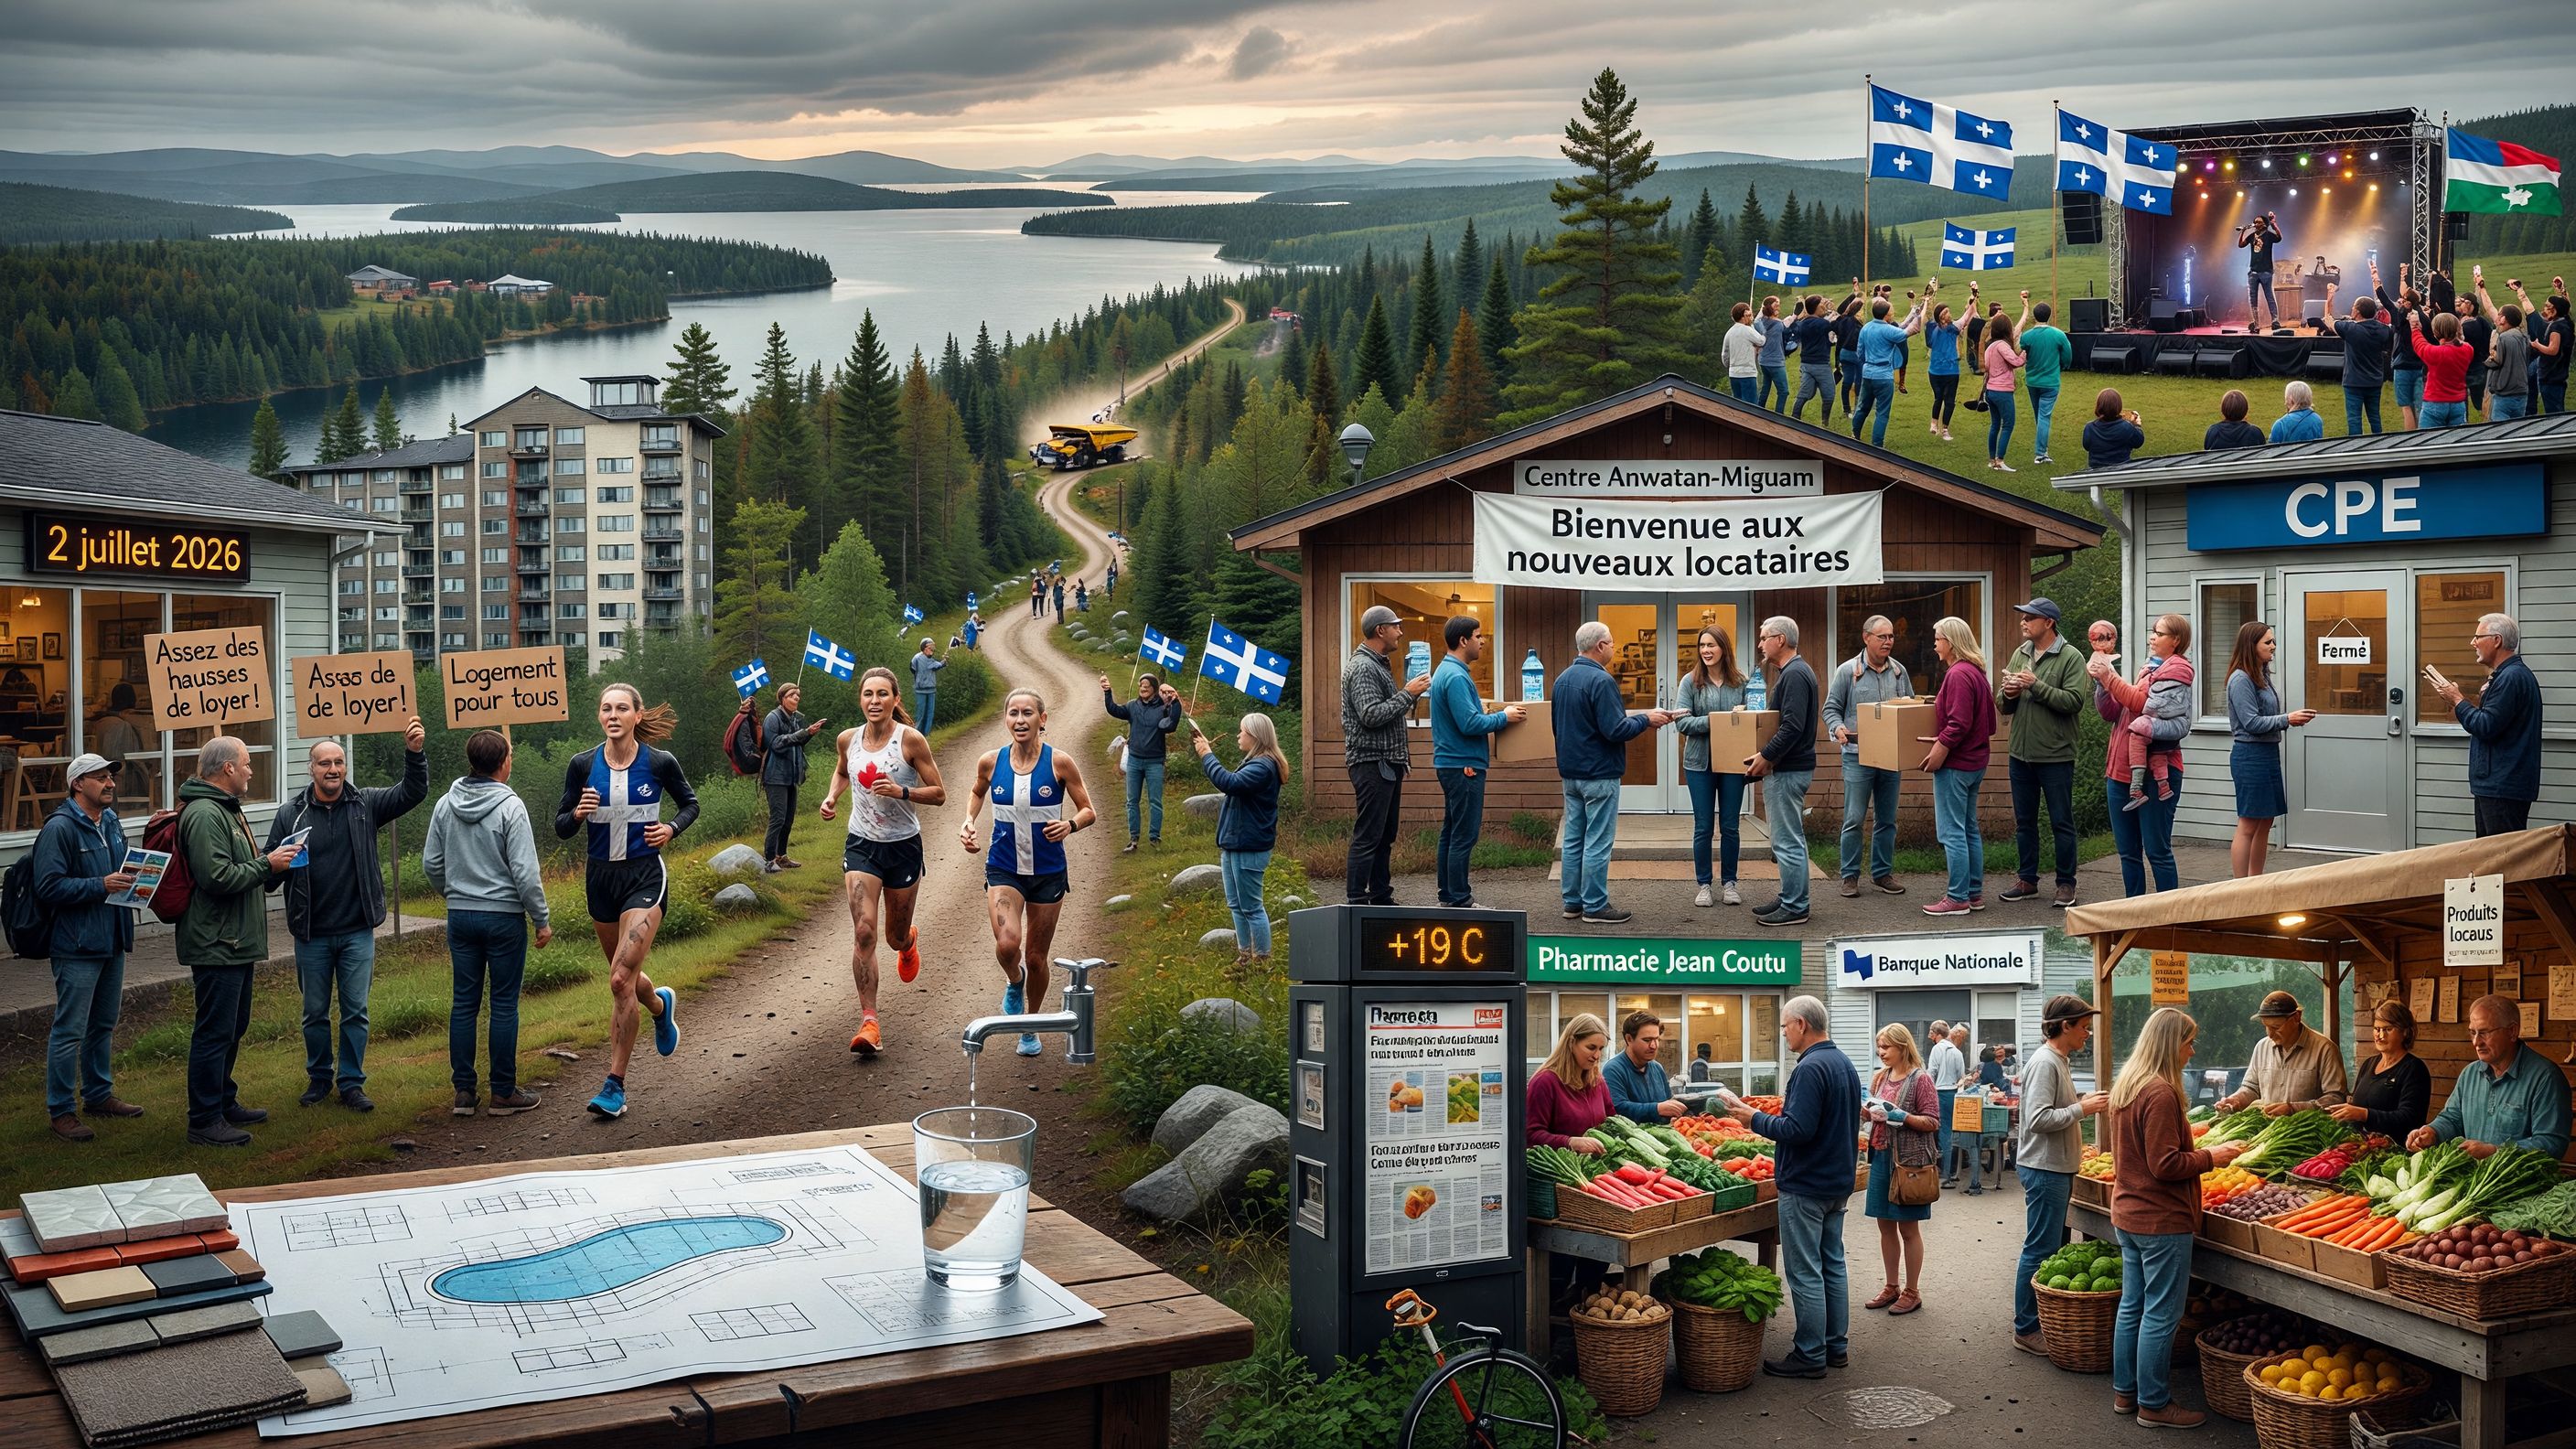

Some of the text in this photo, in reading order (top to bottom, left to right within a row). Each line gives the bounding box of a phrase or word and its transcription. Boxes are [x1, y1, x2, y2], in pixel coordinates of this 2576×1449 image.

[1524, 466, 1815, 495] Centre Anwatan-Miguam
[2285, 476, 2421, 538] CPE
[1551, 507, 1805, 540] Bienvenue aux
[48, 525, 241, 572] 2 juillet 2026
[1508, 543, 1850, 577] nouveaux locataires
[156, 631, 259, 665] Assez des
[2322, 640, 2367, 659] Fermé
[166, 666, 249, 691] hausses
[370, 659, 396, 684] de
[451, 655, 558, 692] Logement
[166, 692, 192, 719] de
[307, 684, 407, 725] de loyer!
[454, 694, 504, 722] pour
[2447, 903, 2498, 923] Produits
[1388, 926, 1484, 965] +19 C
[1539, 946, 1787, 974] Pharmacie Jean Coutu
[1945, 951, 2023, 971] Nationale
